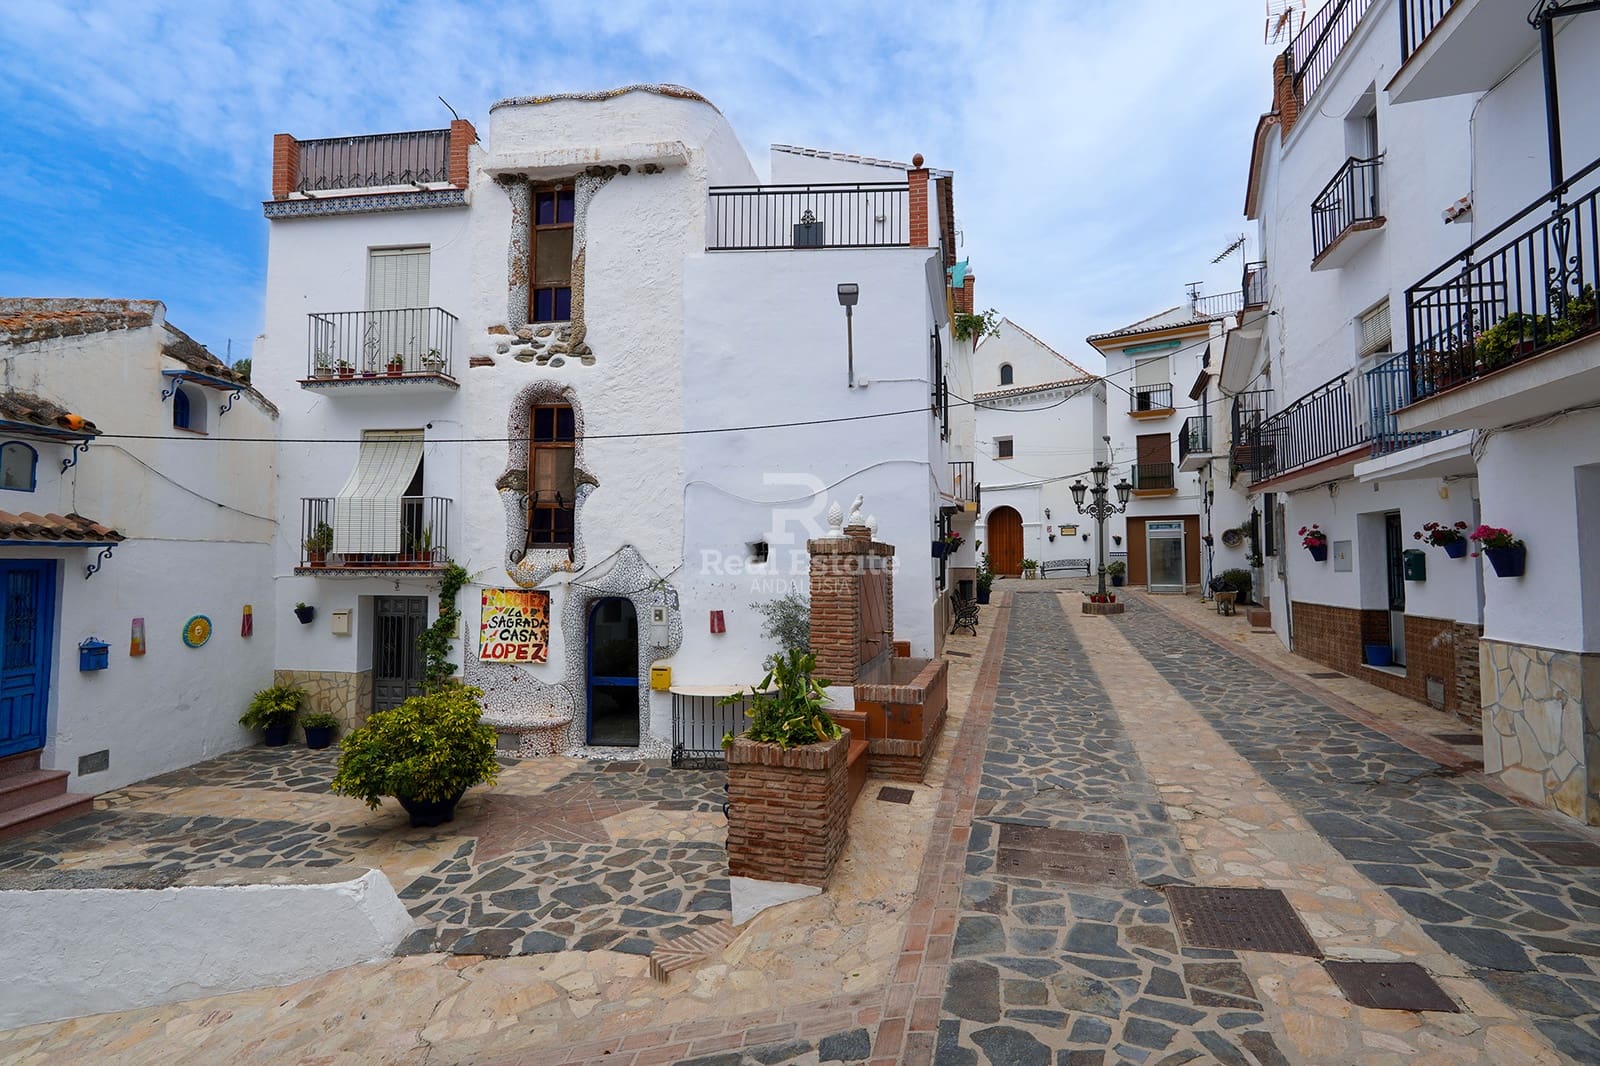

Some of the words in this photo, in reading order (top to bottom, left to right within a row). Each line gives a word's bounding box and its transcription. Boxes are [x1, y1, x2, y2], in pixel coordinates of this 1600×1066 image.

[508, 607, 522, 617] La
[489, 616, 549, 628] SAGRADA
[500, 629, 538, 642] CASA
[481, 643, 545, 661] LOPEZ
